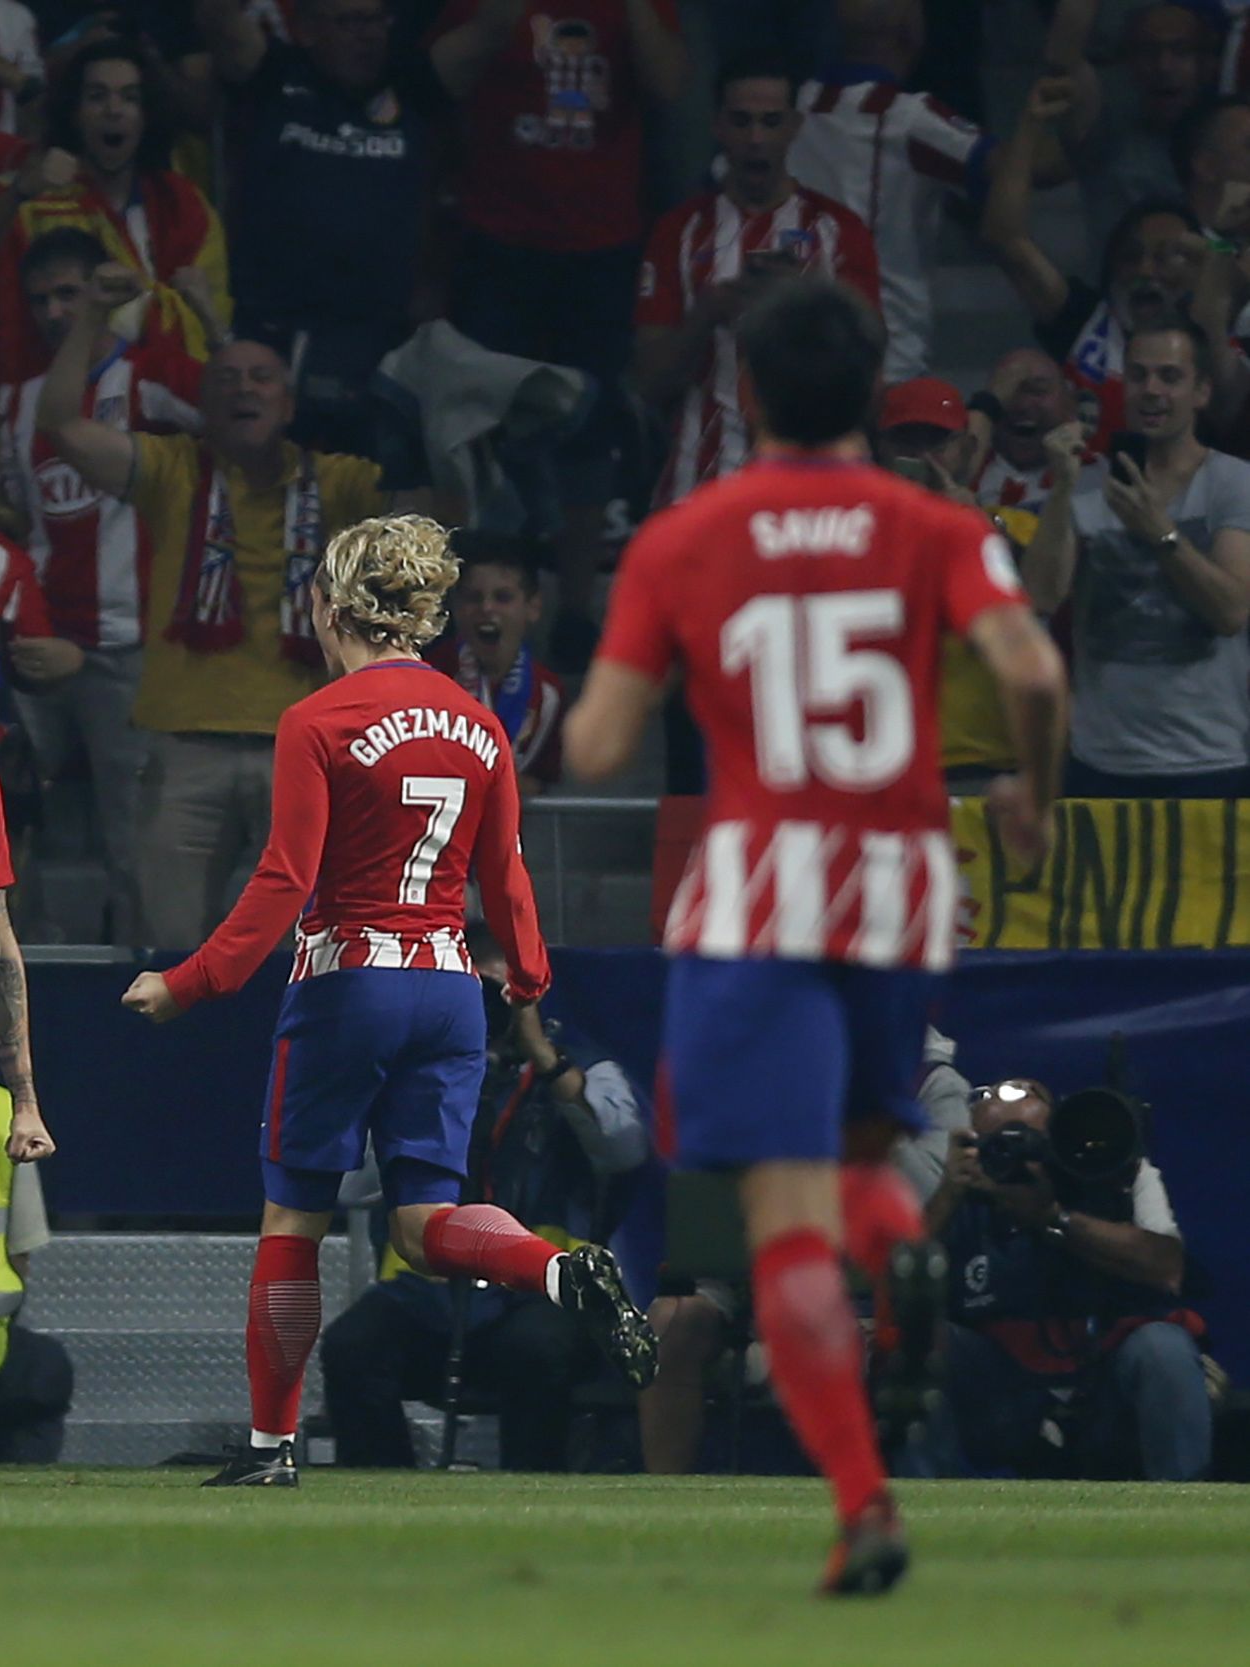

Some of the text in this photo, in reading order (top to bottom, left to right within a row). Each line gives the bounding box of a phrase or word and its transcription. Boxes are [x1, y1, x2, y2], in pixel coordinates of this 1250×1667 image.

[349, 708, 500, 771] GRIEZMANN
[719, 588, 916, 794] 15
[398, 776, 467, 905] 7
